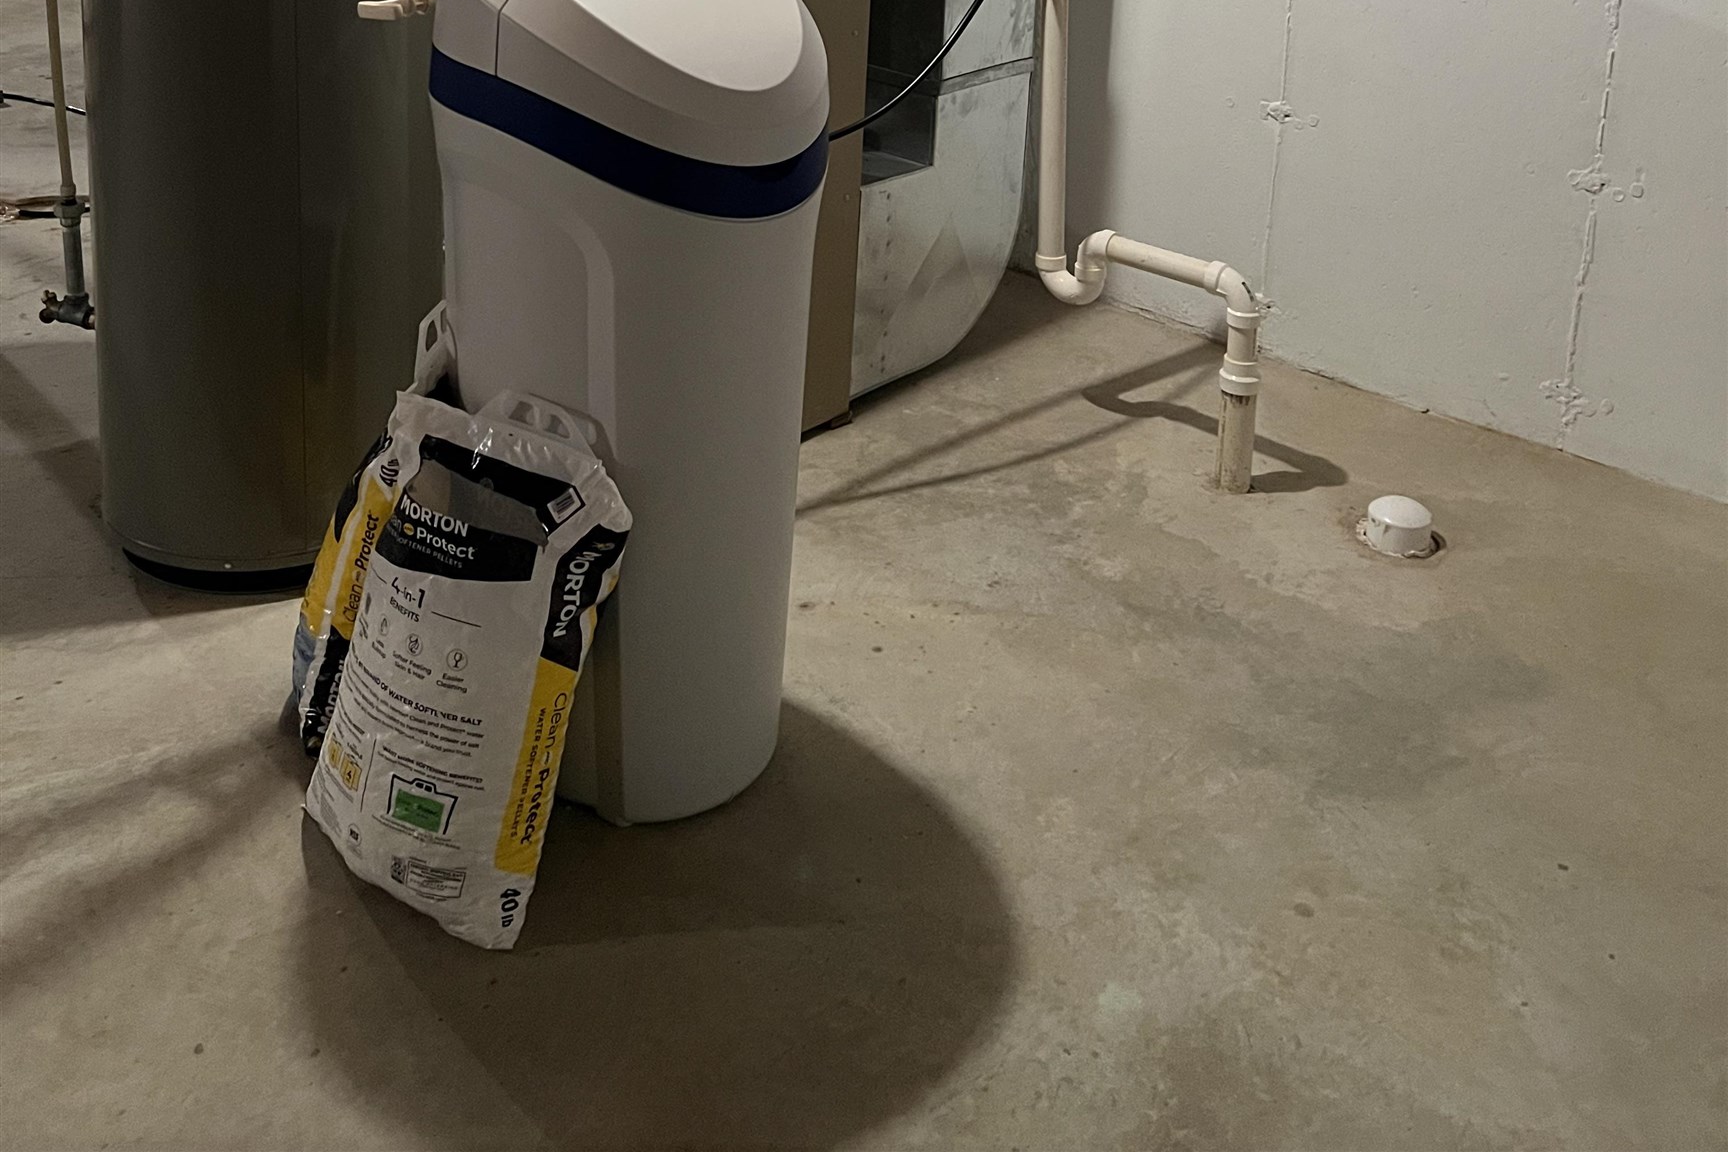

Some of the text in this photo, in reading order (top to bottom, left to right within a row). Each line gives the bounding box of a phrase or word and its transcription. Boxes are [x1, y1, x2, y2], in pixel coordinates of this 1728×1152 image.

[379, 464, 399, 488] 40
[400, 493, 469, 538] MORTON
[416, 526, 476, 560] Protect
[343, 583, 363, 623] Clean
[354, 512, 379, 571] Protect
[389, 596, 420, 623] BENEFITS
[391, 576, 426, 609] 4-in-1
[552, 551, 602, 638] MORTON
[380, 682, 389, 692] OF
[388, 688, 414, 708] WATER
[460, 714, 482, 727] SALT
[534, 707, 547, 742] WATER
[520, 692, 568, 845] Clean Protect
[520, 744, 538, 795] SOFTENER
[510, 798, 524, 839] PELLETS
[500, 887, 521, 928] 40 lb
